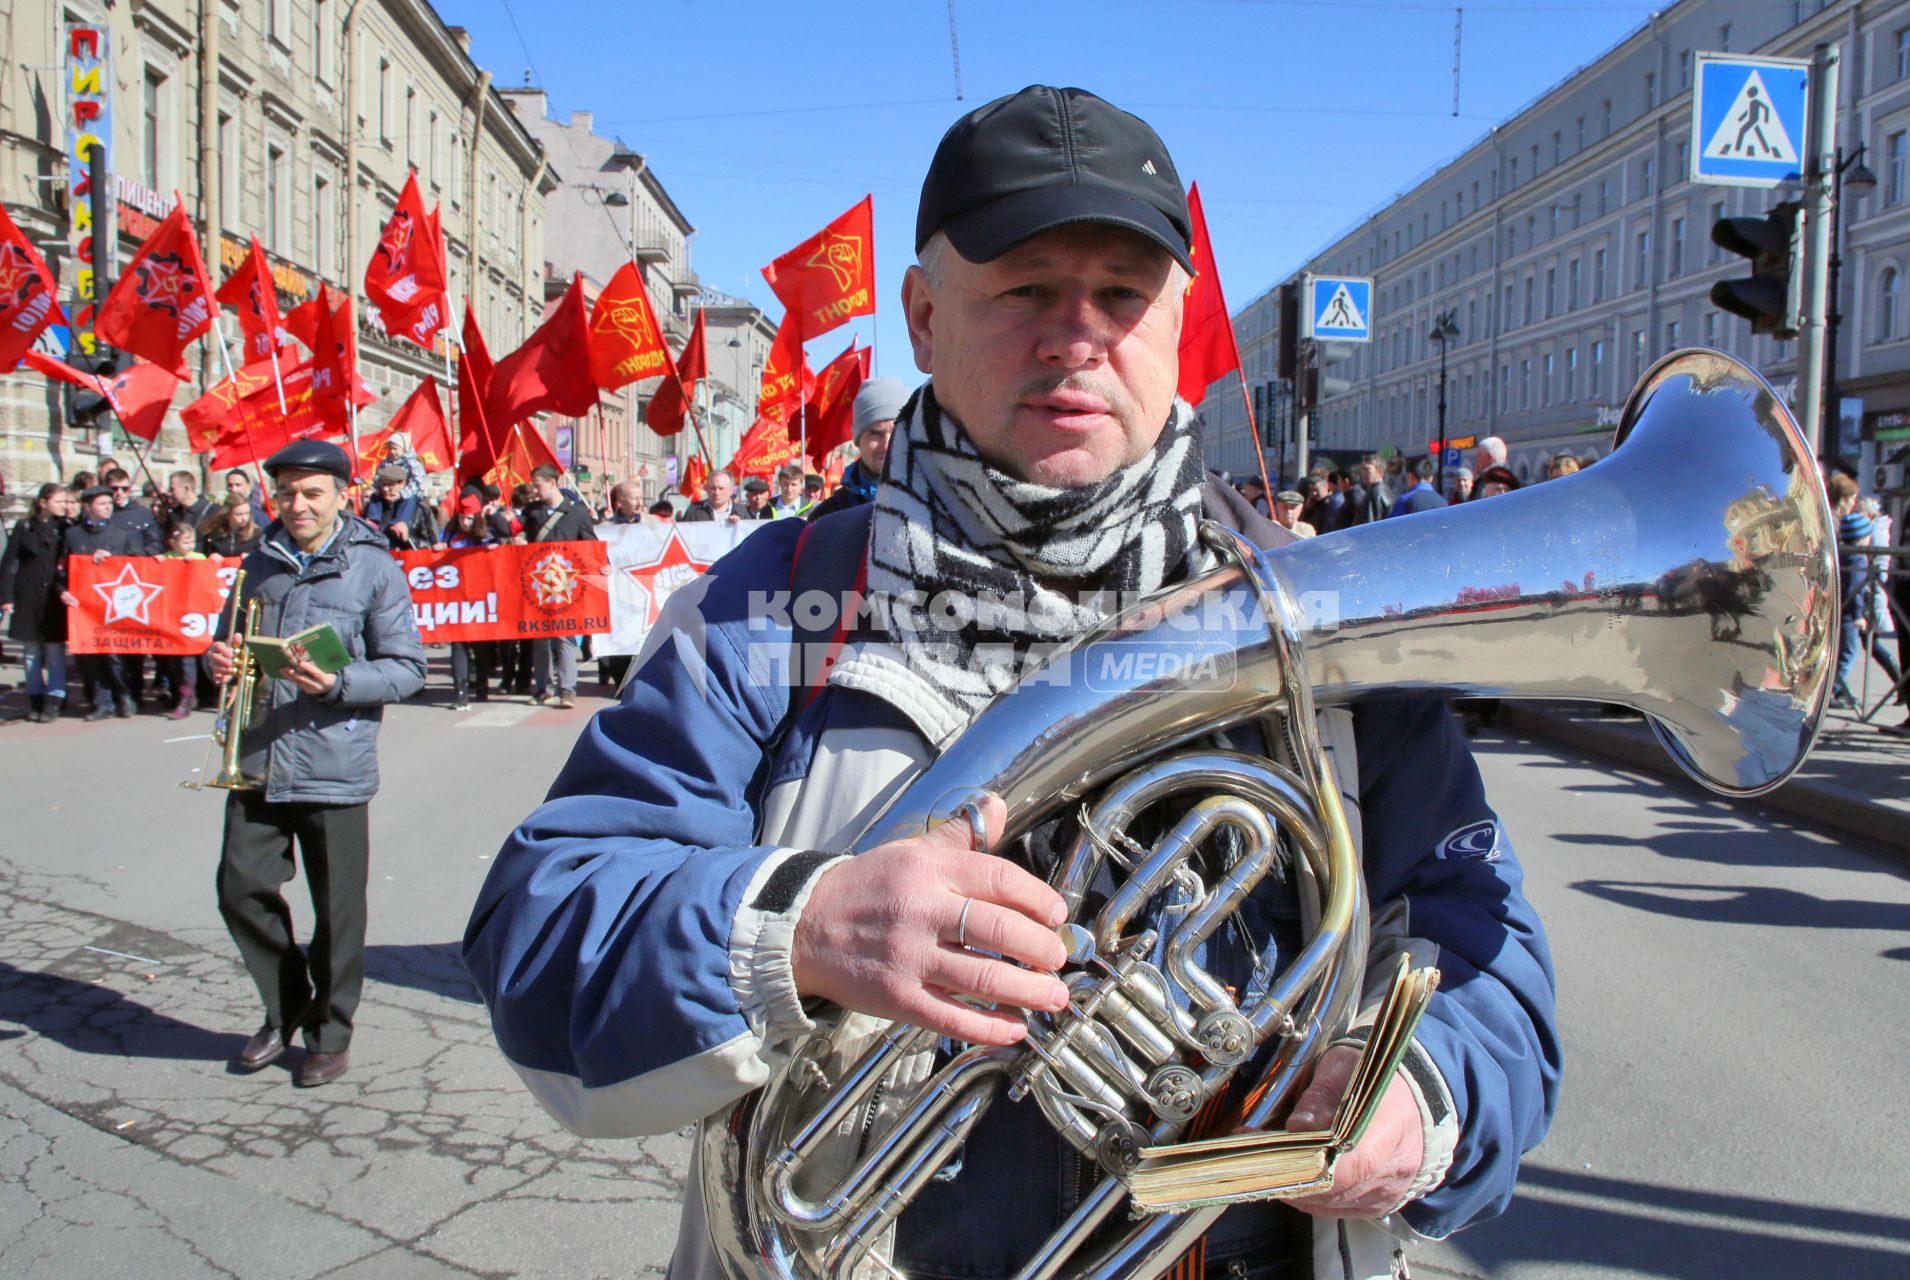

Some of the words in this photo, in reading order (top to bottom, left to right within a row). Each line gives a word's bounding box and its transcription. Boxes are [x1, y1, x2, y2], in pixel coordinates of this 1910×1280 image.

[396, 560, 460, 590] ез
[413, 592, 498, 631] ции!
[517, 616, 608, 633] RKSMB.RU
